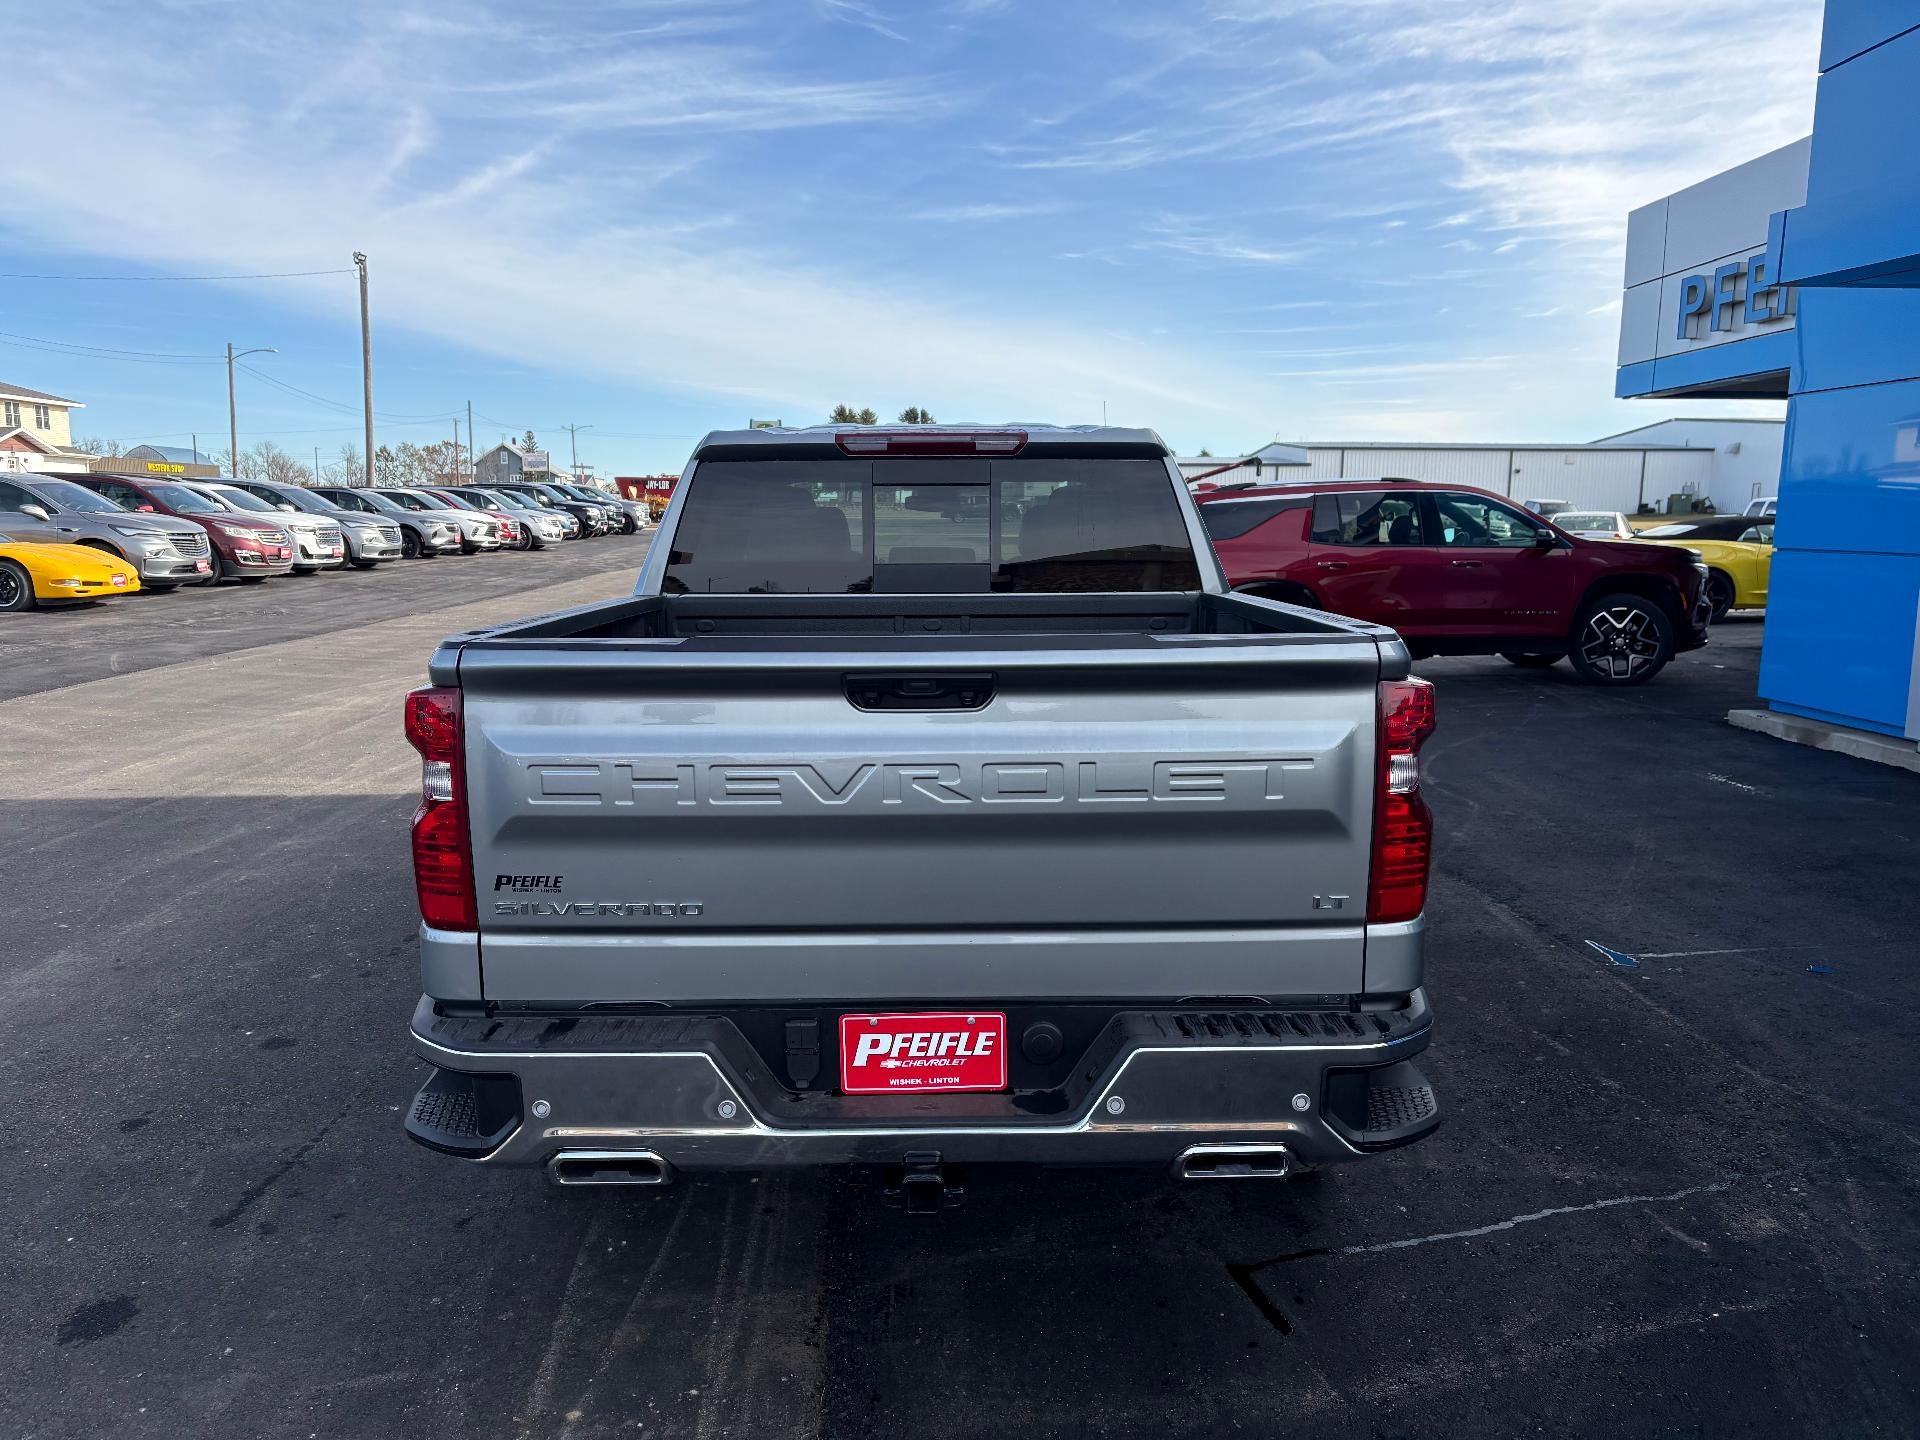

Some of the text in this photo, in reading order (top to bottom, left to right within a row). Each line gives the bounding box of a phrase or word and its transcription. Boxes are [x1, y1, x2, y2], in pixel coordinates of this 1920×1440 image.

[527, 758, 1315, 805] CHEVROLET
[494, 874, 563, 891] PFEIFLE
[494, 902, 704, 916] SILVERADO
[1312, 895, 1350, 910] LT
[852, 1032, 997, 1067] PFEIFLE
[902, 1058, 968, 1068] CHEVROLET
[889, 1078, 923, 1086] WISHEK
[929, 1076, 960, 1085] LINTON
